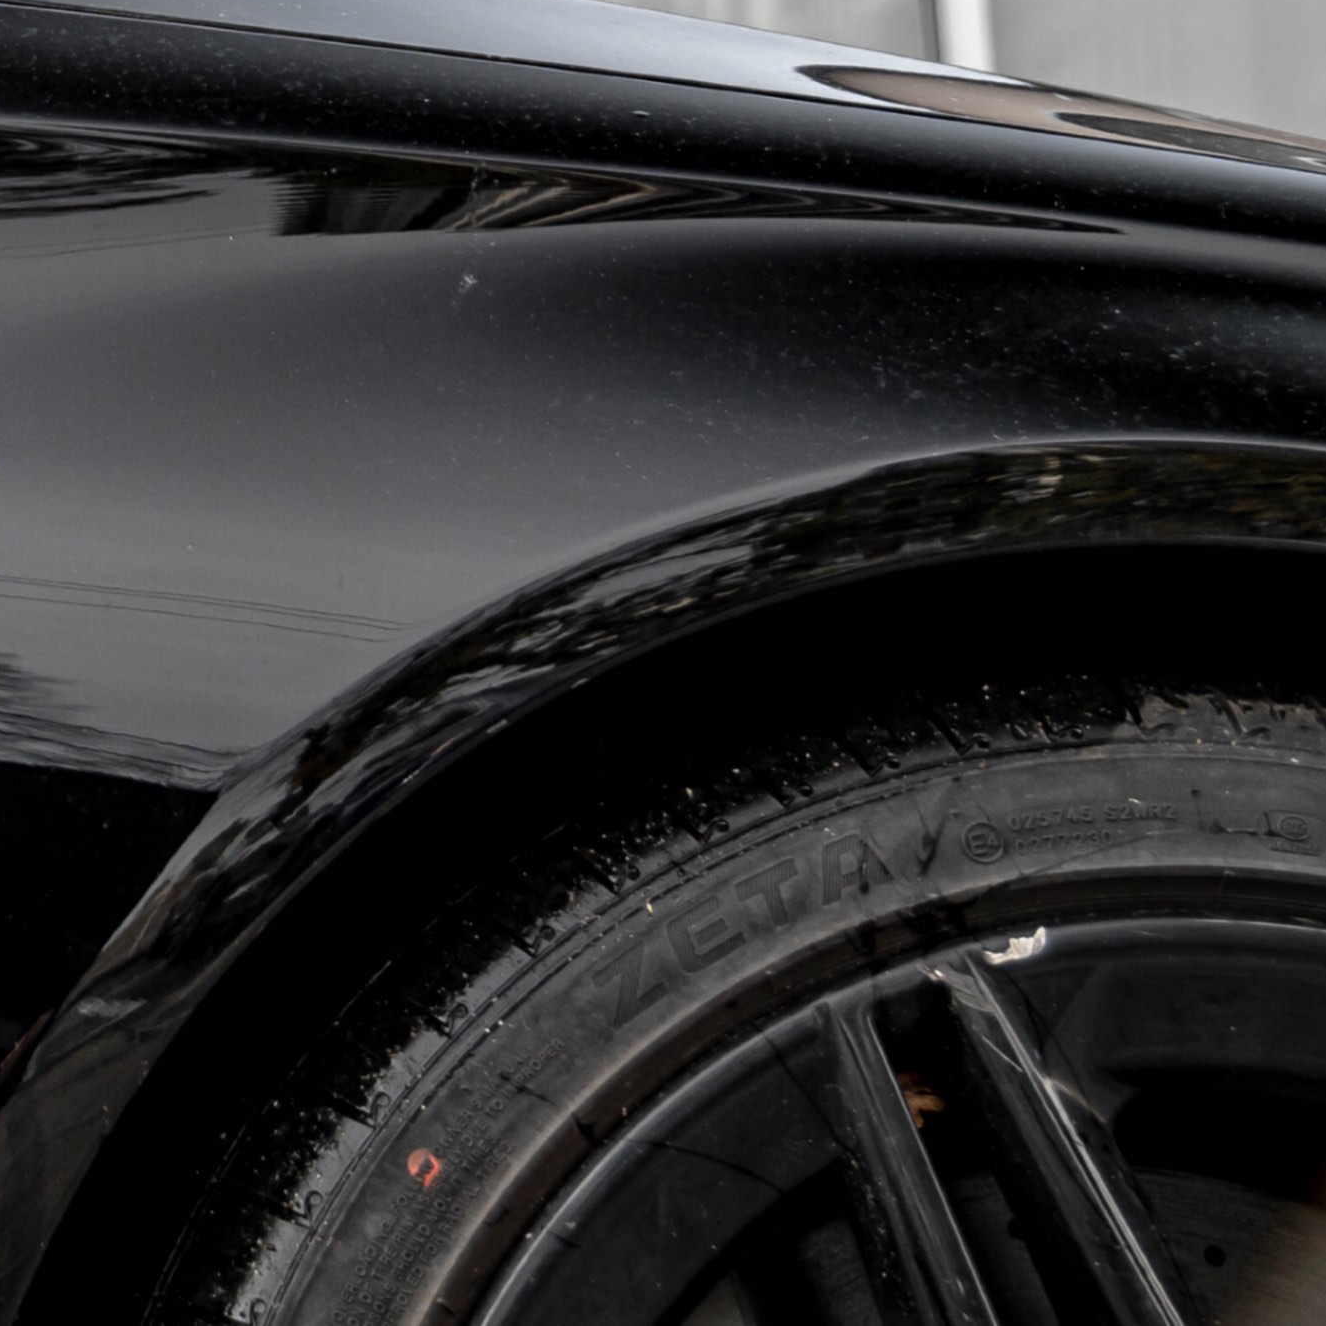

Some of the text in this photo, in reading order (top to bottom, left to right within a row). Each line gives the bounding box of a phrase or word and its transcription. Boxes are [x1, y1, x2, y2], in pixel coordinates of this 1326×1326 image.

[592, 833, 895, 1028] ZETA
[357, 1282, 377, 1304] OF
[458, 1115, 488, 1147] DUE
[482, 1095, 506, 1120] TO
[418, 1232, 445, 1264] FOR
